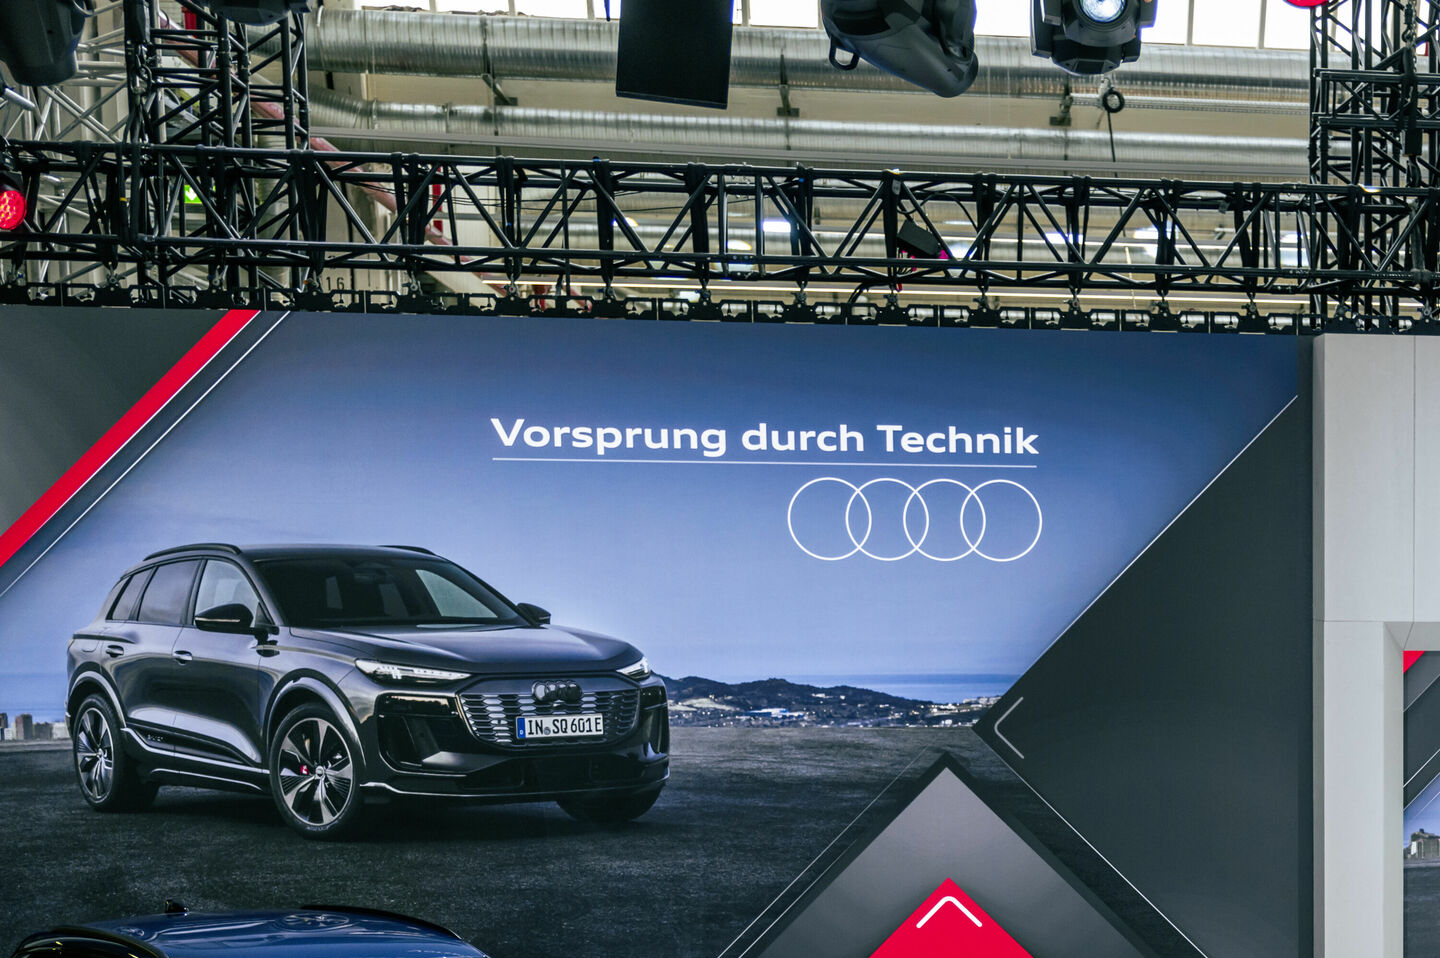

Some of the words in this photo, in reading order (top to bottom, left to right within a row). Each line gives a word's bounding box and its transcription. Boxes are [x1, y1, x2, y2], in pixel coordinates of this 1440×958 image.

[490, 417, 726, 458] Vorsprung
[741, 422, 864, 452] durch
[876, 424, 1040, 454] Technik
[528, 720, 544, 735] IN
